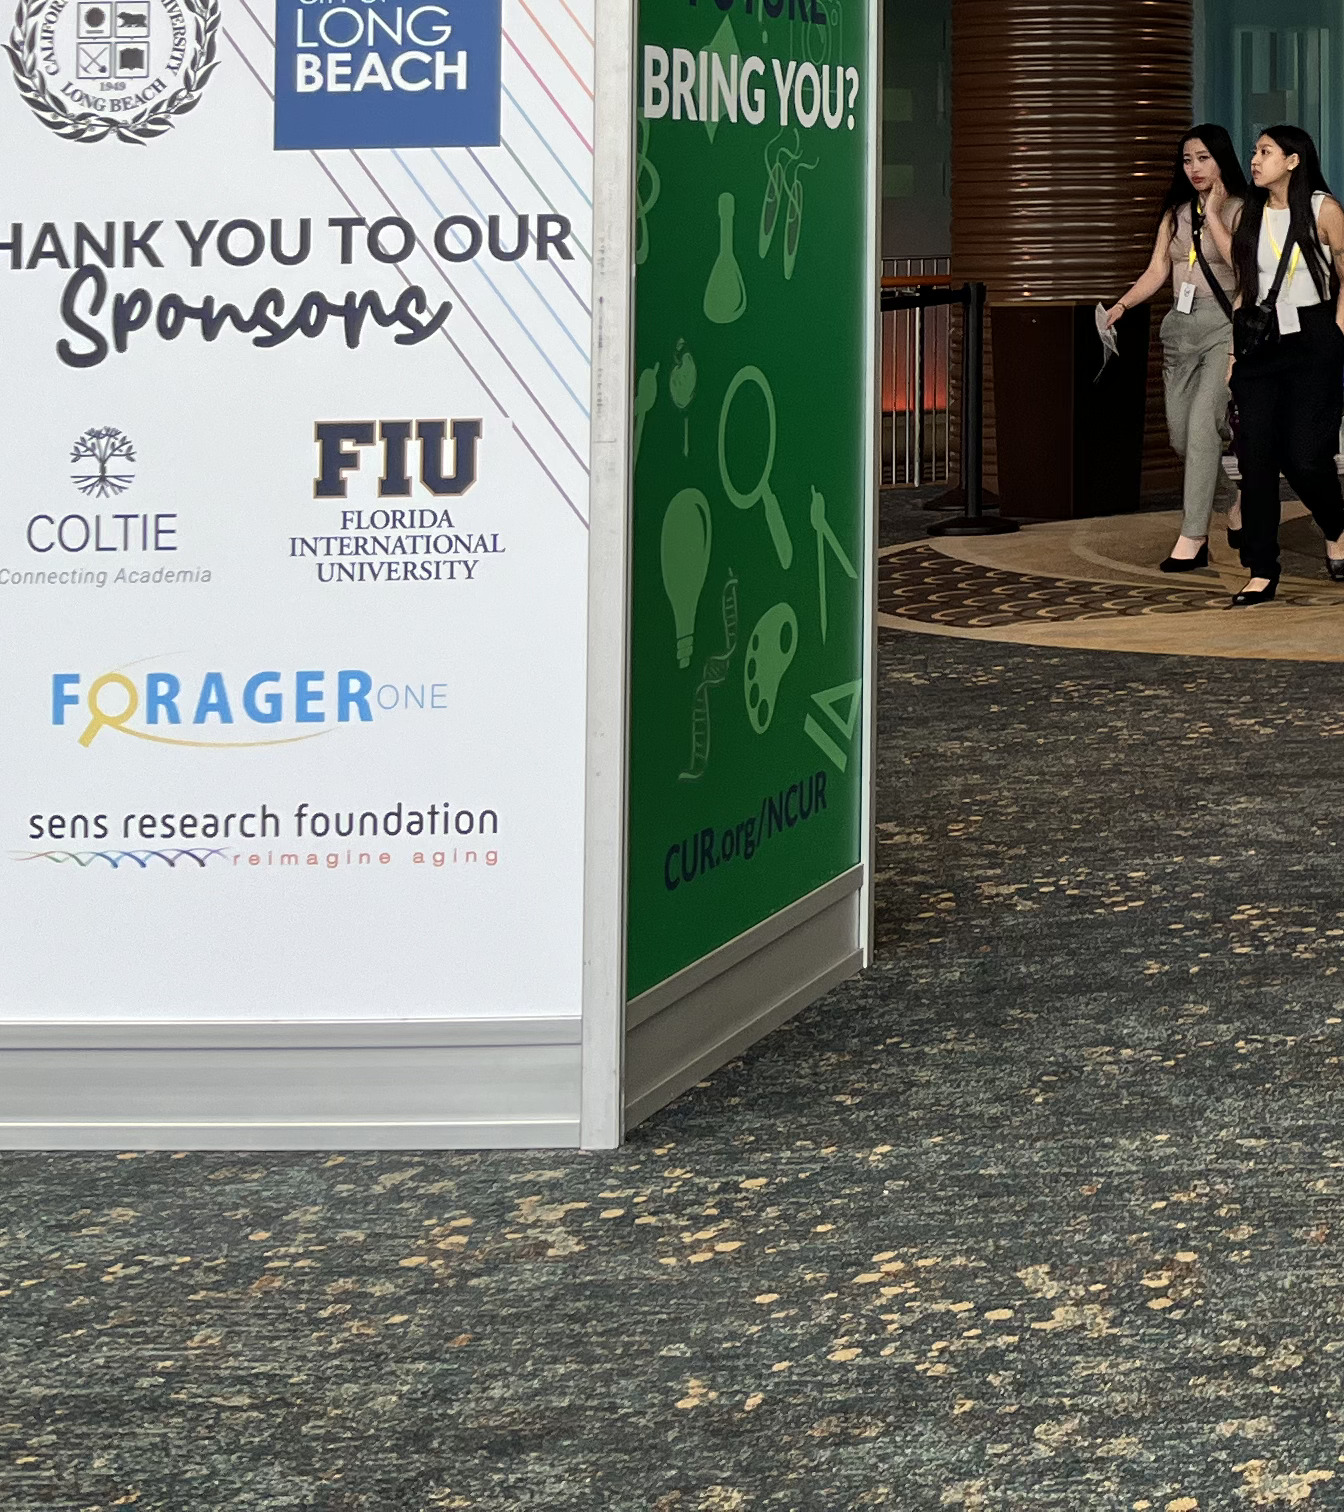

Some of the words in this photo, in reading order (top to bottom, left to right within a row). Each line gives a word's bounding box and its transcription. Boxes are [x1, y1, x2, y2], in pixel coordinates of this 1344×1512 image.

[297, 6, 452, 48] LONG
[297, 51, 468, 92] BEACH
[644, 43, 765, 128] BRING
[772, 53, 859, 132] YOU?
[60, 82, 107, 111] LONG
[110, 78, 168, 112] BEACH
[0, 219, 164, 270] HANK
[175, 216, 313, 268] YOU
[329, 215, 418, 264] TO
[433, 213, 575, 262] OUR
[55, 262, 453, 368] Sponsors
[313, 417, 483, 499] FIU
[26, 513, 178, 554] COLTIE
[341, 510, 454, 530] FLORIDA
[289, 533, 506, 558] INTERNATIONAL
[0, 566, 108, 588] Connecting
[114, 565, 213, 585] Academia
[316, 560, 479, 583] UNIVERSITY
[28, 813, 108, 839] sens
[123, 808, 280, 839] research
[295, 803, 499, 836] foundation
[663, 769, 829, 891] CUR.org/NCUR
[233, 848, 391, 869] reimagine
[413, 847, 499, 867] aging
